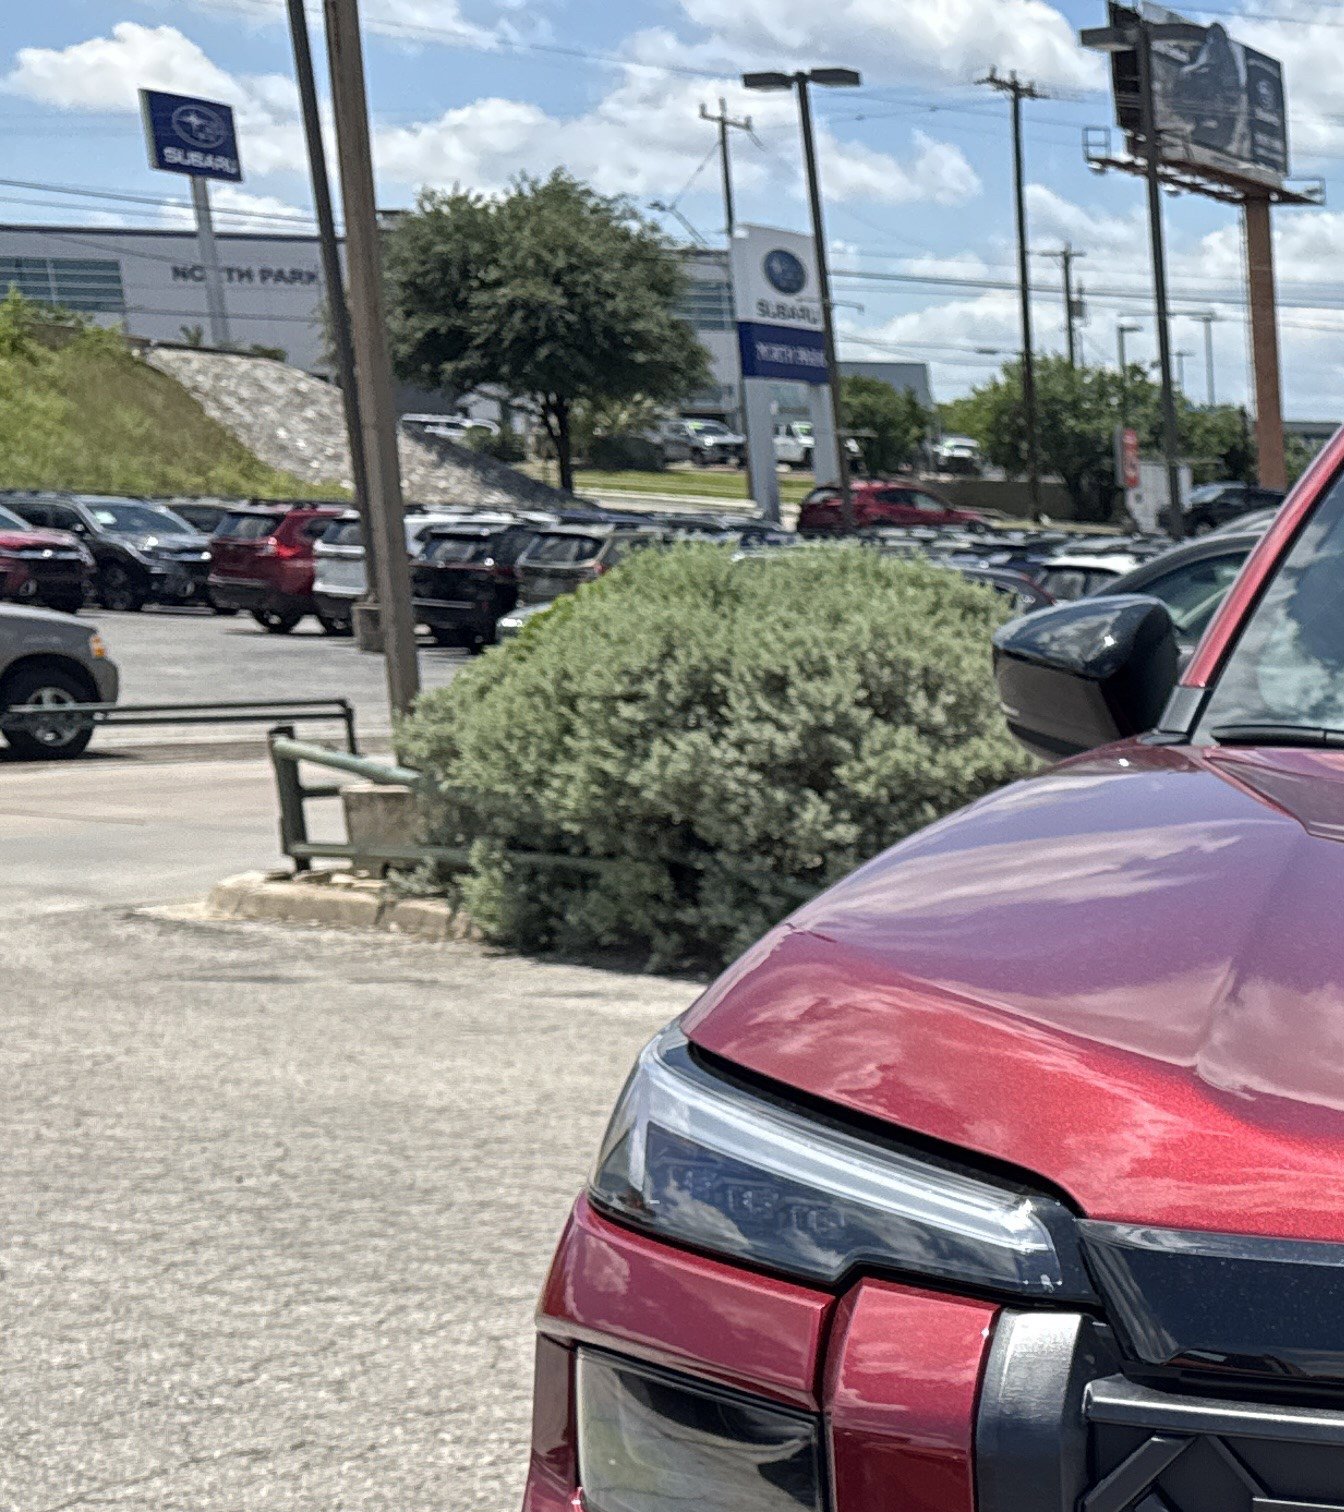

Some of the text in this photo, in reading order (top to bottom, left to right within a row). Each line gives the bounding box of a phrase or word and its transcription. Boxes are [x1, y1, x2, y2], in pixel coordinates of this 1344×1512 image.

[163, 146, 237, 174] SUBARU
[172, 264, 319, 286] NOTH PARK
